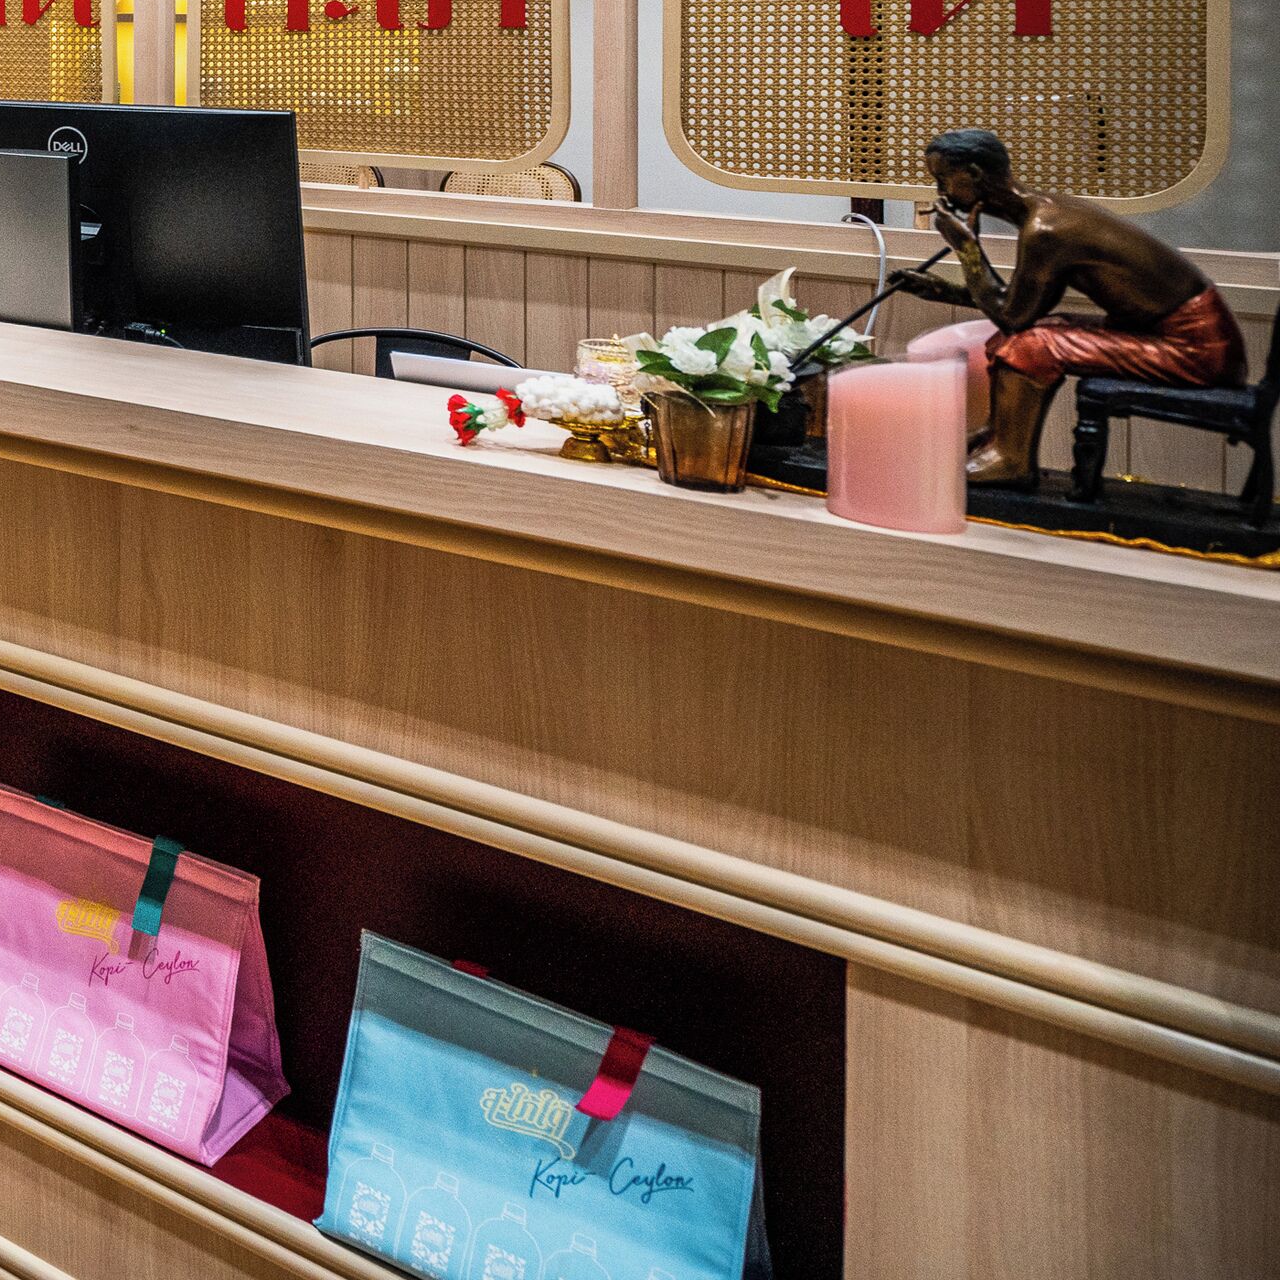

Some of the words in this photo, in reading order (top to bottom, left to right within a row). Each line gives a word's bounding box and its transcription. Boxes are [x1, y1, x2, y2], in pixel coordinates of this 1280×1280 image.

[52, 141, 84, 153] DELL
[142, 948, 200, 985] Ceylon
[608, 1157, 695, 1205] Ceylon
